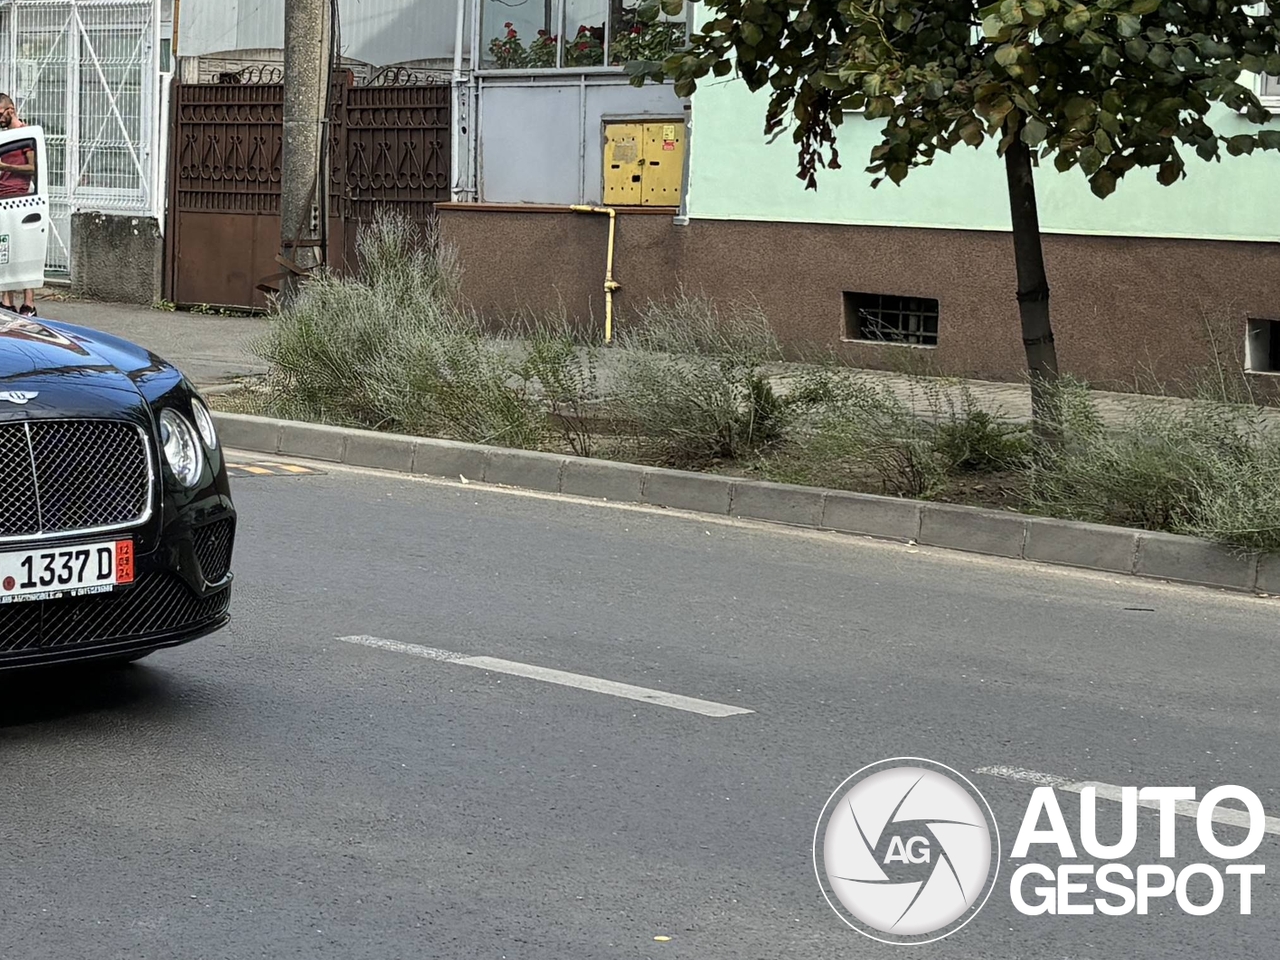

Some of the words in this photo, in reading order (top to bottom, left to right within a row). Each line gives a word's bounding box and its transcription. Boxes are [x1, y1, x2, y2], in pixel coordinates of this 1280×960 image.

[119, 544, 129, 555] 12
[20, 549, 90, 589] 1337
[96, 547, 113, 580] D
[118, 568, 130, 579] 24
